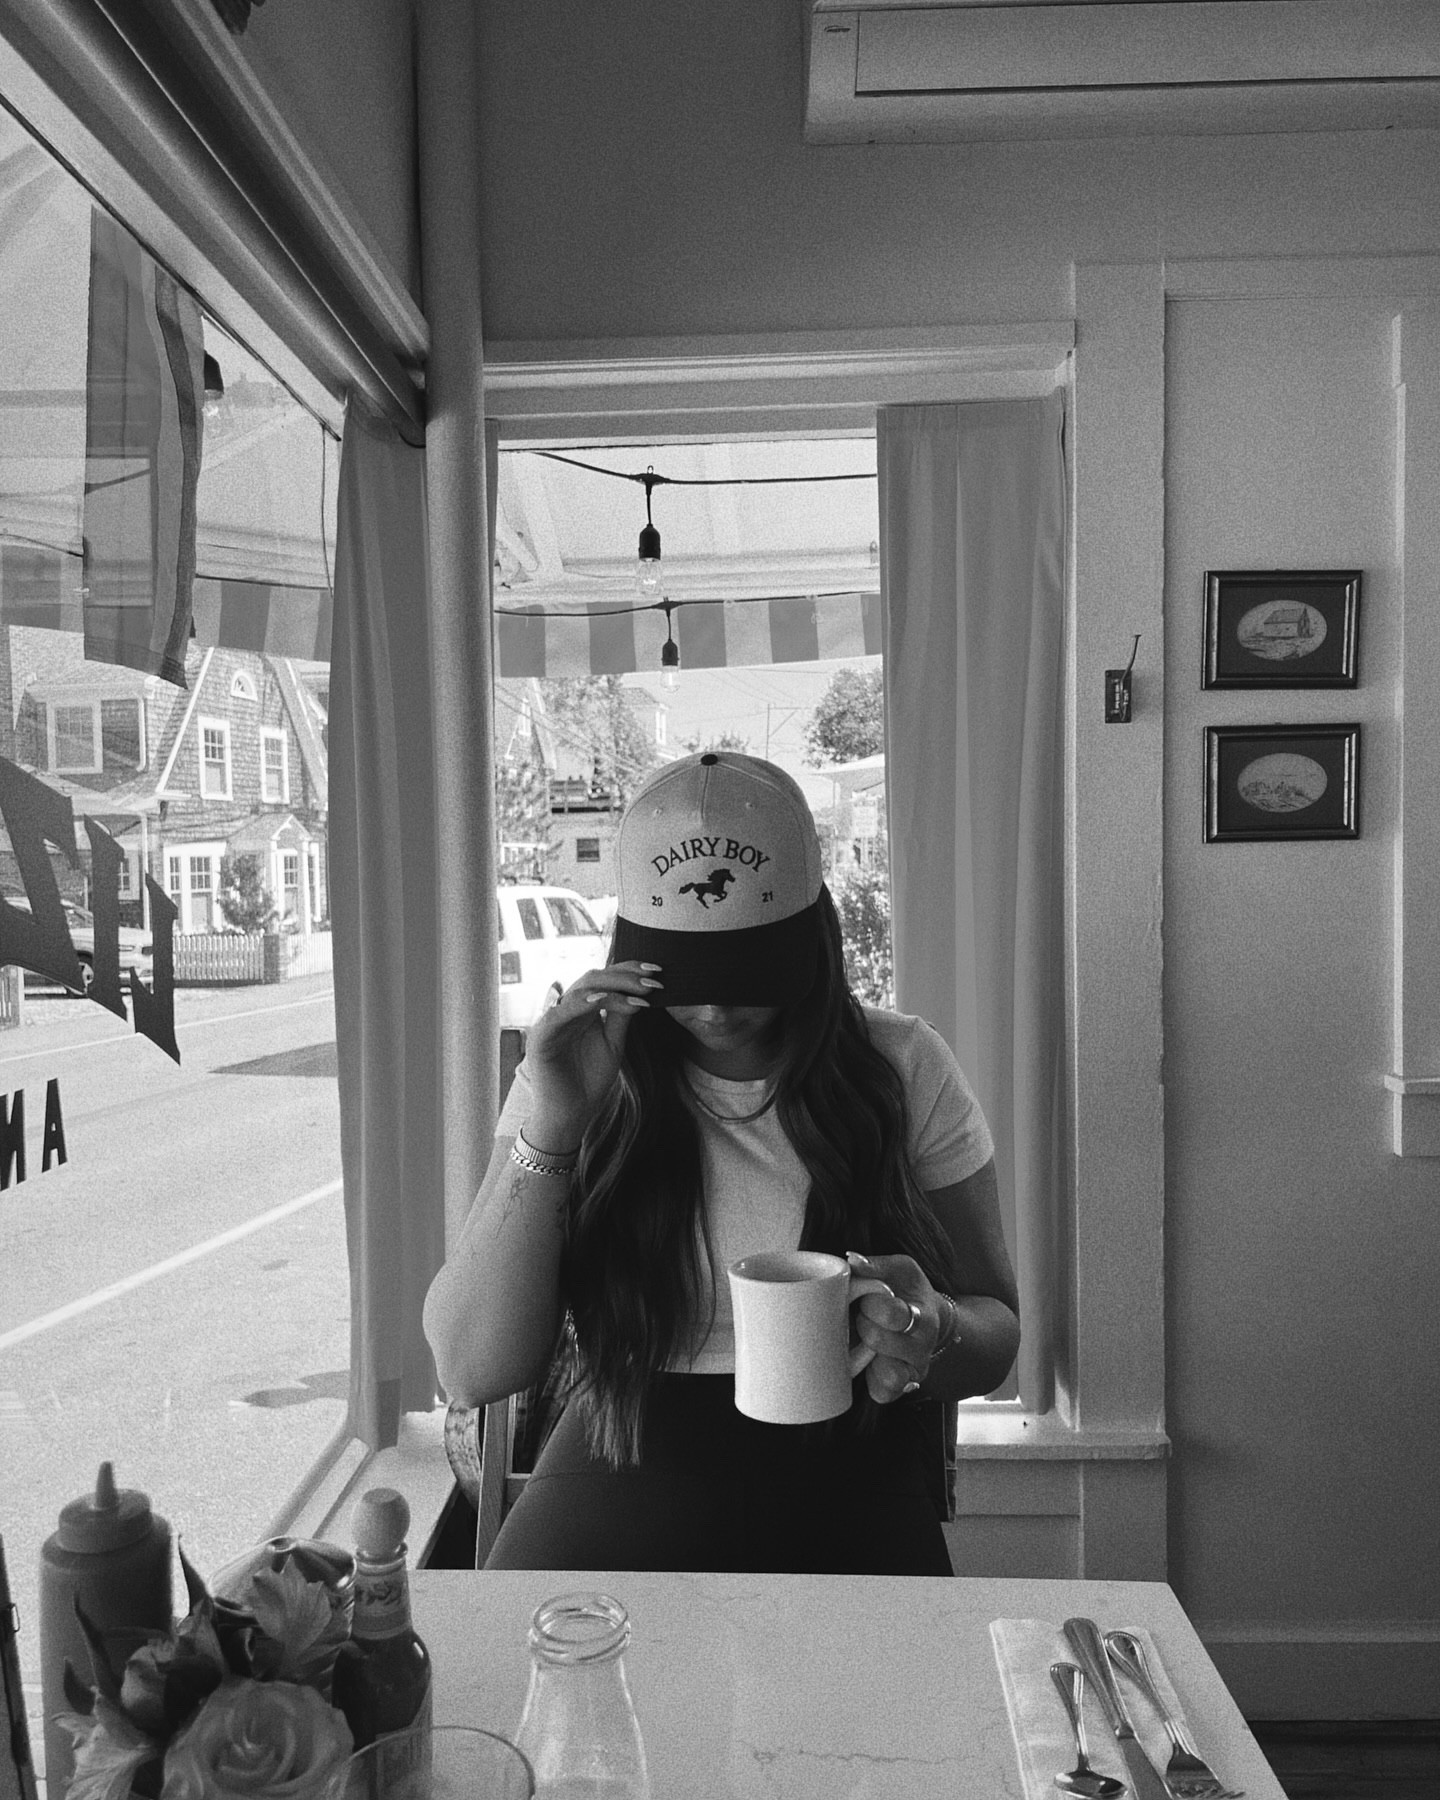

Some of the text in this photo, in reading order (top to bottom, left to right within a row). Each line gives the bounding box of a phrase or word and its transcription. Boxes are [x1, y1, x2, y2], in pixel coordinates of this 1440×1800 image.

[651, 836, 771, 877] DAIRY BOY
[651, 891, 774, 907] 20 21
